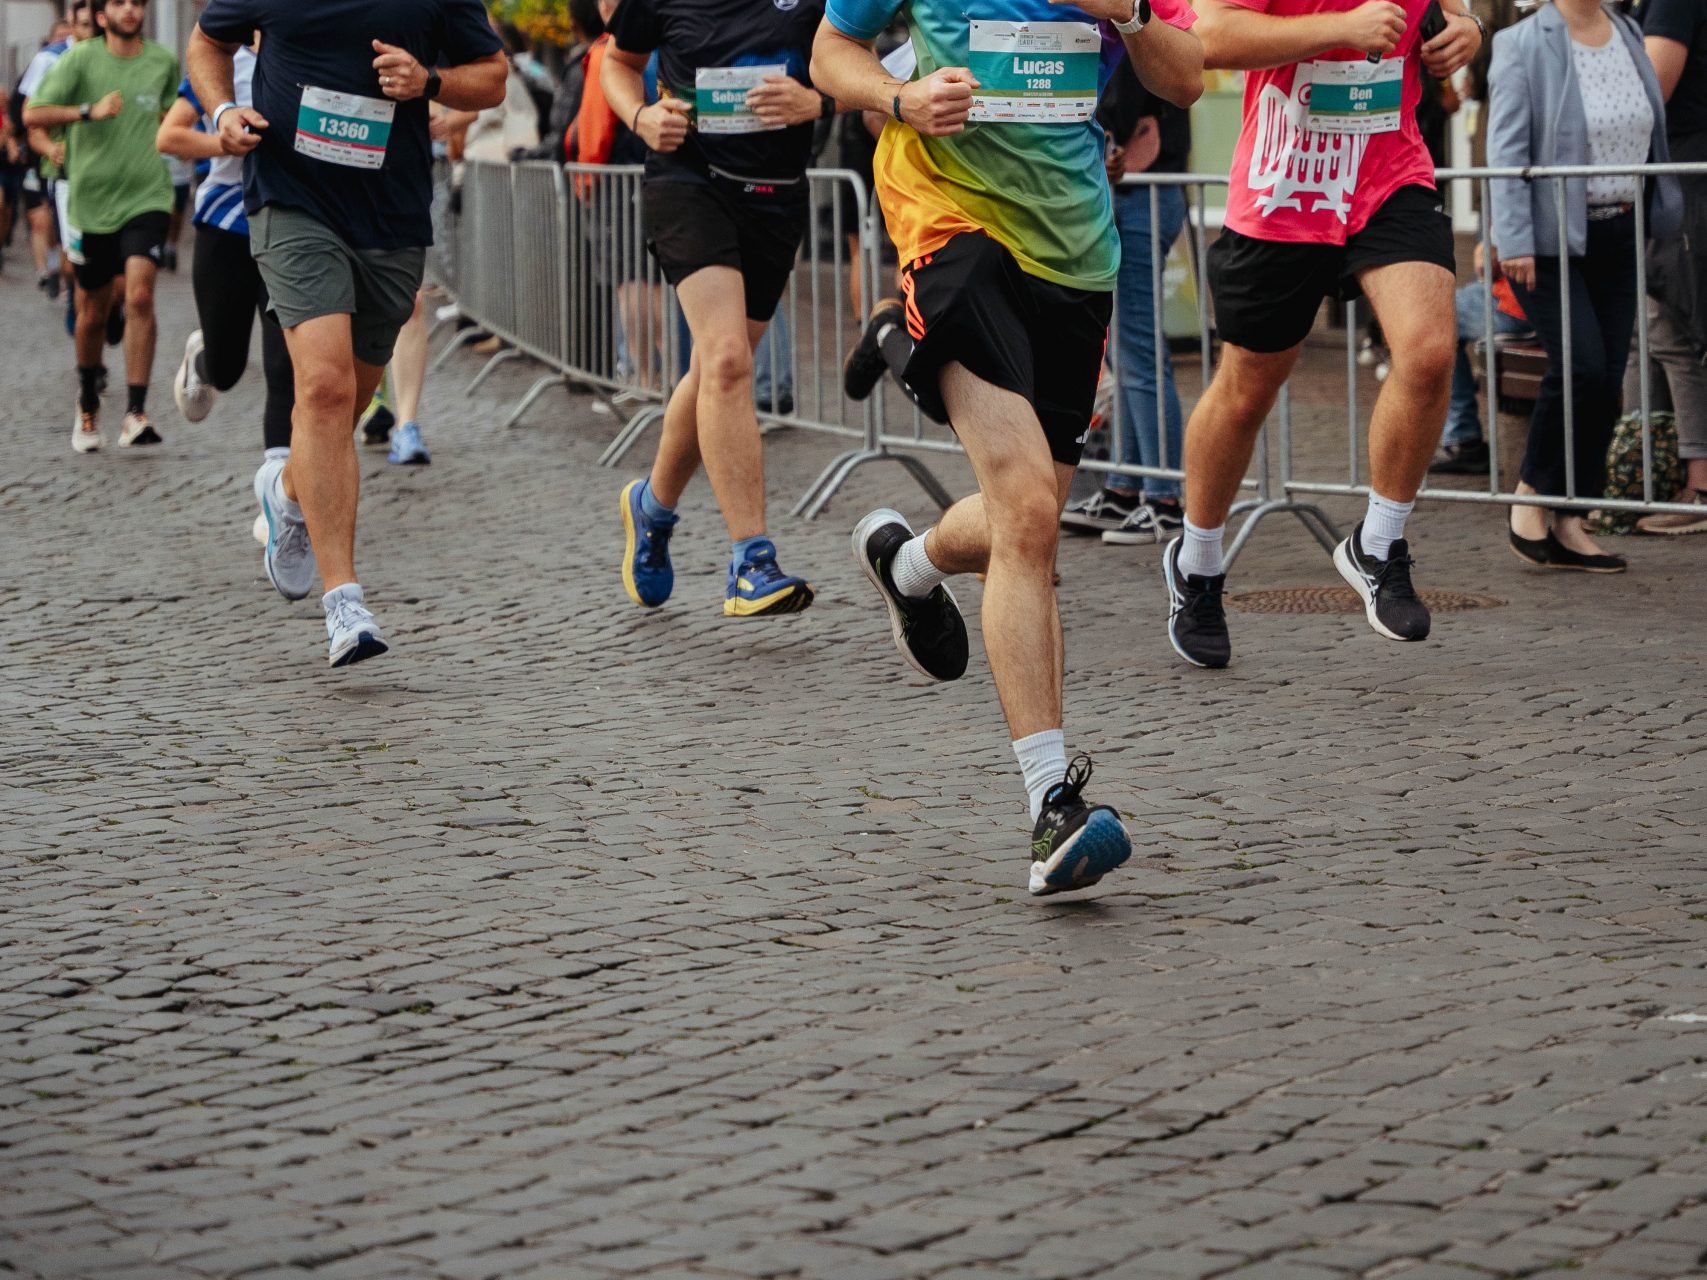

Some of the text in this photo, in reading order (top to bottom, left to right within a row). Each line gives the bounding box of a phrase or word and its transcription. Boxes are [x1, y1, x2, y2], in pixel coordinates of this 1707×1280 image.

[1013, 56, 1065, 75] Lucas
[1025, 78, 1052, 89] 1288
[711, 90, 749, 104] Sebas
[1349, 86, 1373, 101] Ben
[319, 116, 370, 141] 13360
